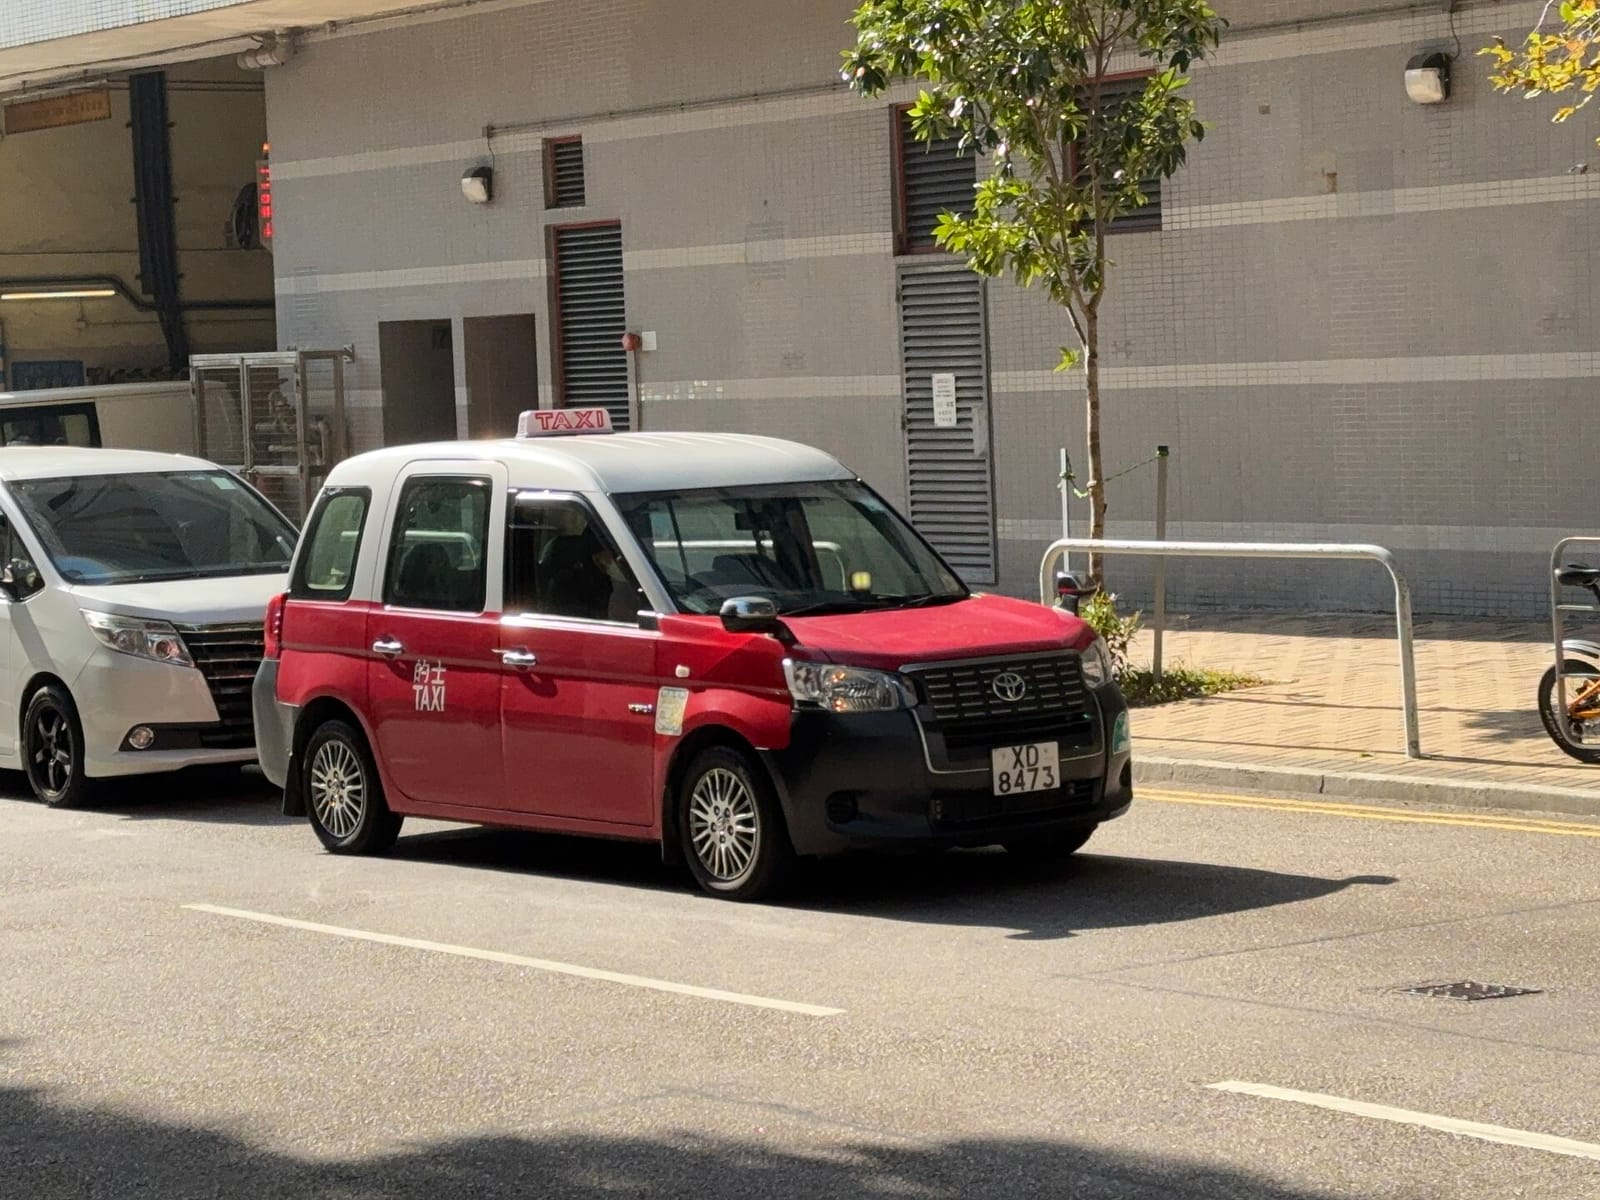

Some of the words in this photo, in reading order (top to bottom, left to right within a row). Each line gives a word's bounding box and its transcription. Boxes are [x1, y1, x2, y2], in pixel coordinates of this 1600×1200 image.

[535, 410, 604, 430] TAXI
[413, 659, 446, 684] 的士
[412, 685, 445, 712] TAXI
[1012, 745, 1039, 769] XD
[998, 766, 1054, 793] 8473
